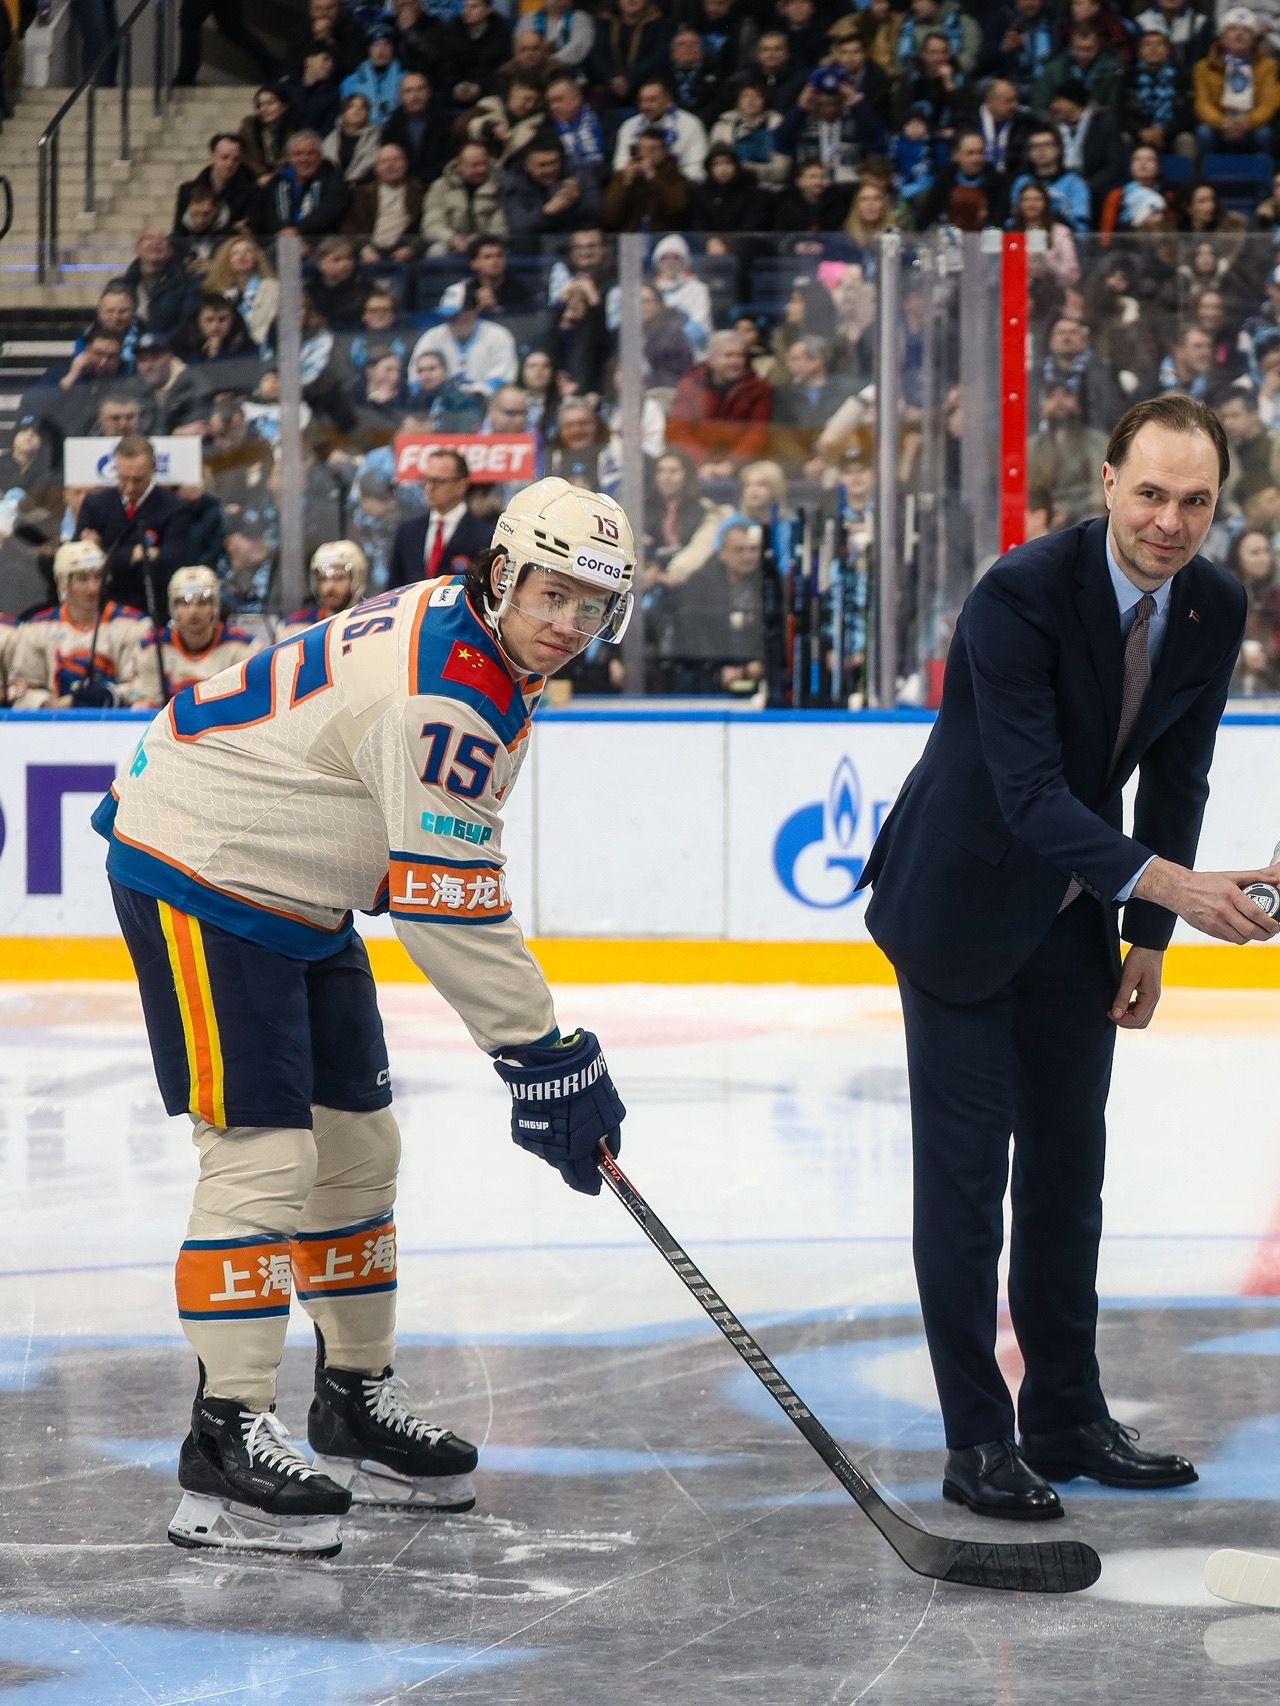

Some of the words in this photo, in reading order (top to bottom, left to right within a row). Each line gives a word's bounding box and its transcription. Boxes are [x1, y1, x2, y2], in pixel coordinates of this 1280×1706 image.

[398, 443, 532, 473] FOBET
[498, 521, 515, 536] CCM
[592, 514, 619, 541] 15
[420, 721, 500, 800] 15
[602, 1158, 622, 1183] LPHA
[200, 1408, 226, 1427] TRUE
